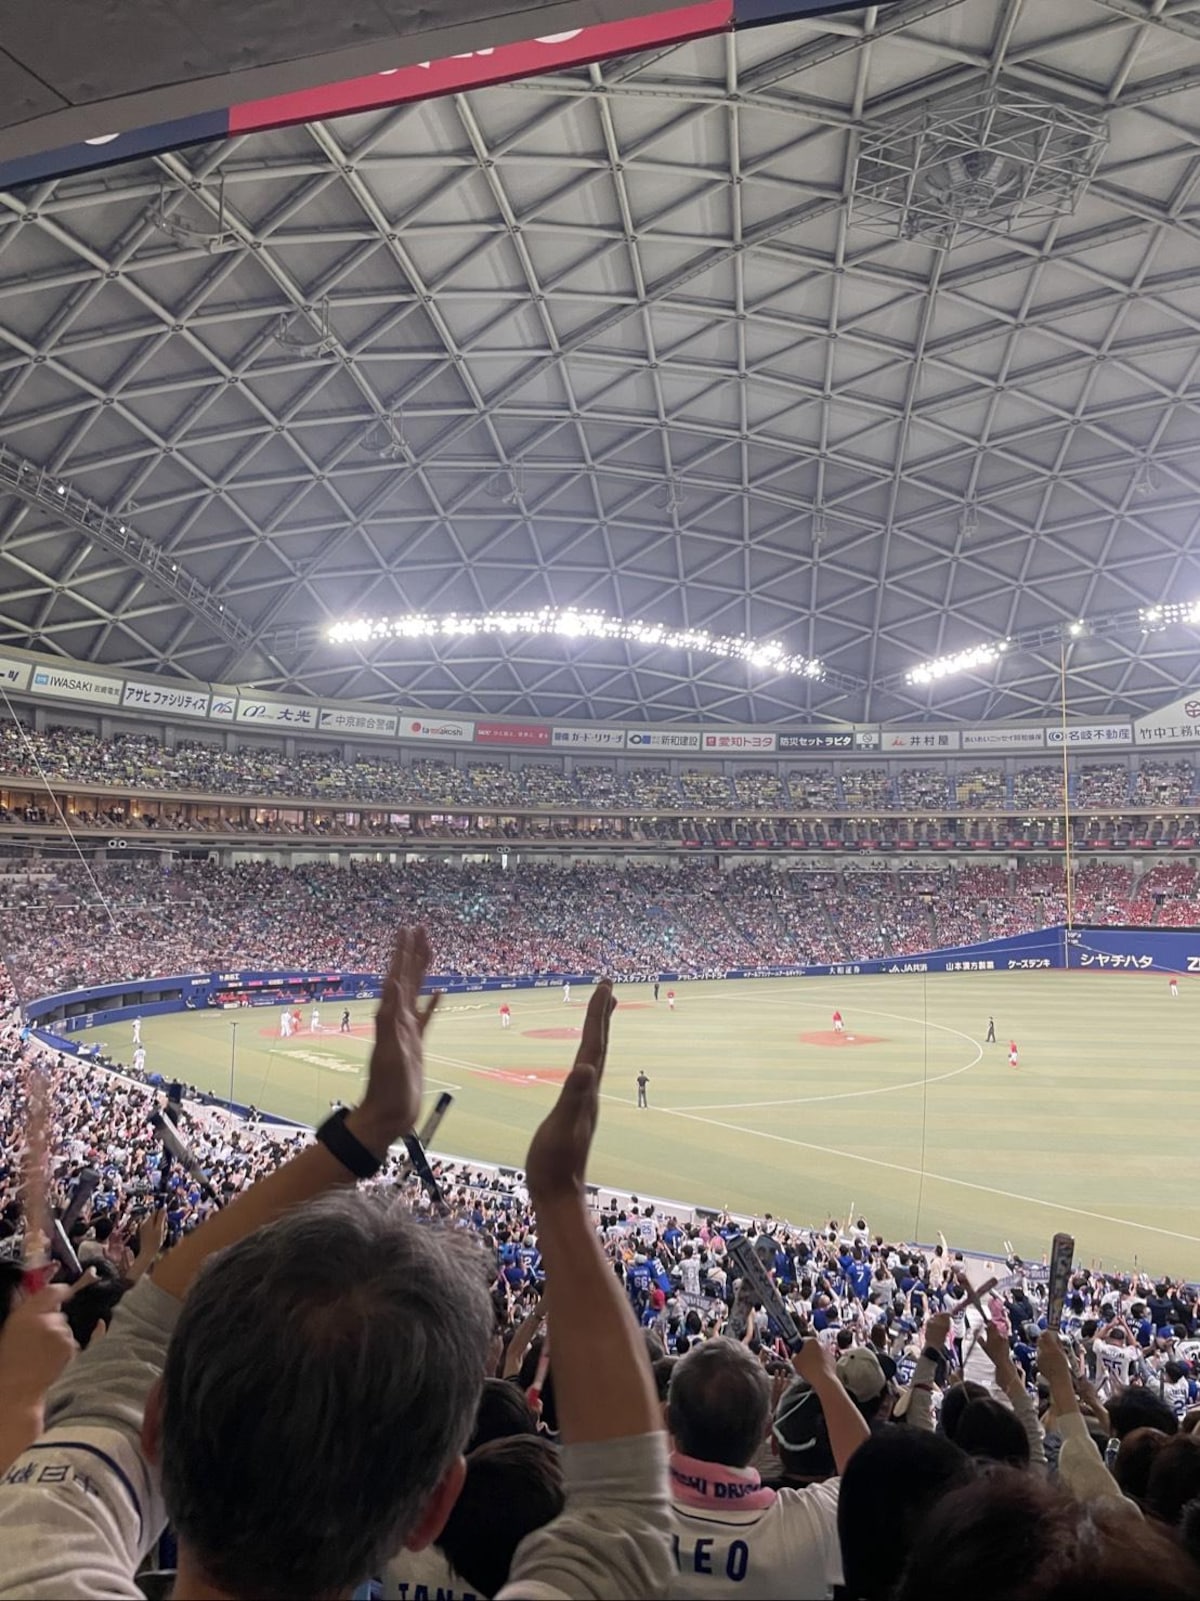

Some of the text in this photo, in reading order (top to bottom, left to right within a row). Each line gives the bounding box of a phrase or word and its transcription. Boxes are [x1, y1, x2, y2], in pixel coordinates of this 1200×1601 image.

[50, 675, 93, 692] IWASAKI
[277, 708, 312, 723] 大光
[718, 736, 773, 747] 愛知トヨタ
[910, 735, 949, 746] 井村屋
[1007, 958, 1051, 970] ケーズデンキ
[1080, 953, 1153, 969] シヤチハタ
[856, 1271, 865, 1283] 7
